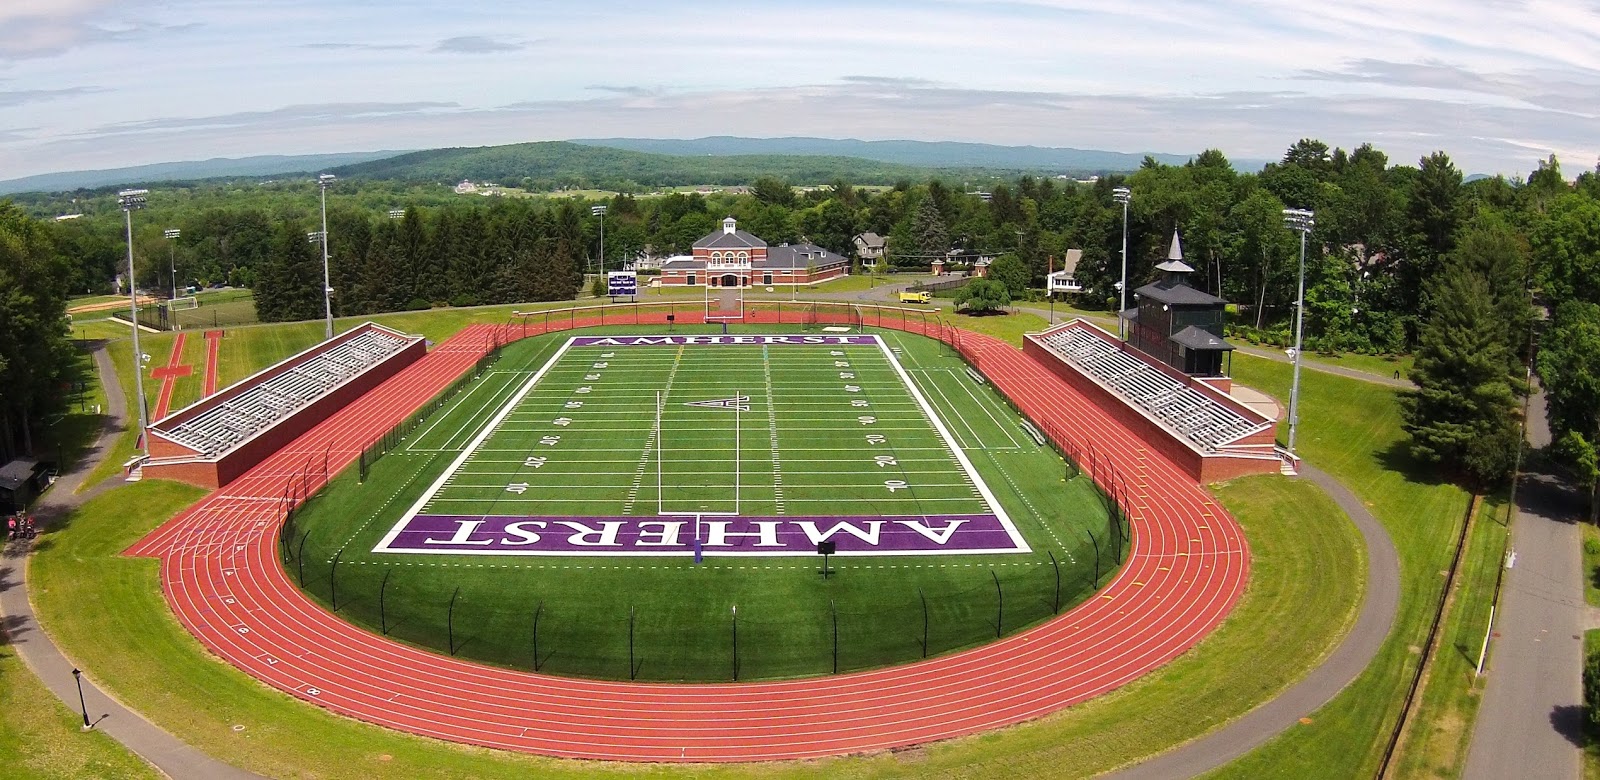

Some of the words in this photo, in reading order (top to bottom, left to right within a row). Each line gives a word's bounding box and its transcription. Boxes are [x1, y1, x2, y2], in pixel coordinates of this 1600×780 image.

[586, 336, 860, 345] AMHERST
[683, 396, 750, 411] A
[539, 435, 560, 445] 30
[865, 434, 885, 444] 30
[524, 456, 547, 467] 20
[874, 455, 897, 467] 20
[506, 482, 529, 493] 10
[884, 480, 907, 491] 10
[424, 519, 971, 546] AMHERST
[306, 688, 320, 696] 8
